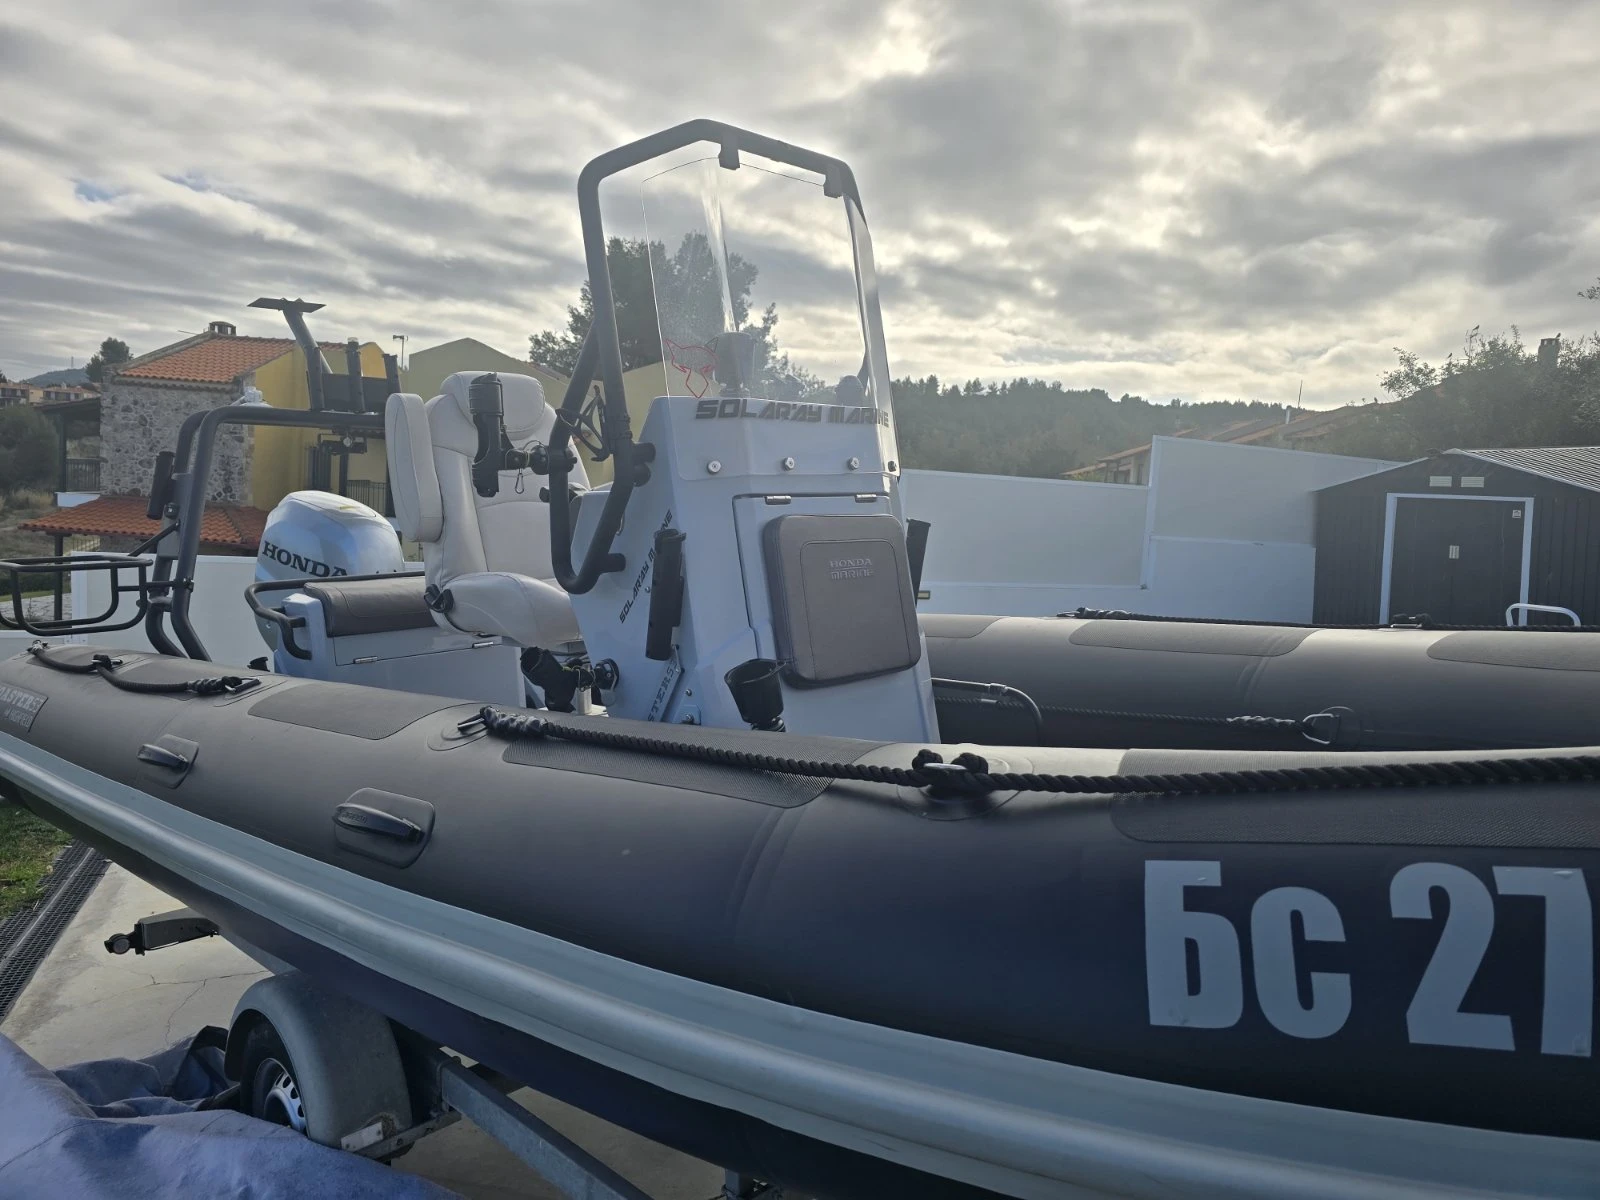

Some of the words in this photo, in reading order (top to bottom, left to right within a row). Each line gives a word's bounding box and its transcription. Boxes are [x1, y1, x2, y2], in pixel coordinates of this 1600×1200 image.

[828, 406, 890, 428] MARINE
[262, 540, 348, 578] HONDA
[829, 558, 873, 567] HONDA
[831, 568, 875, 580] MARINE
[1390, 862, 1593, 1057] 27
